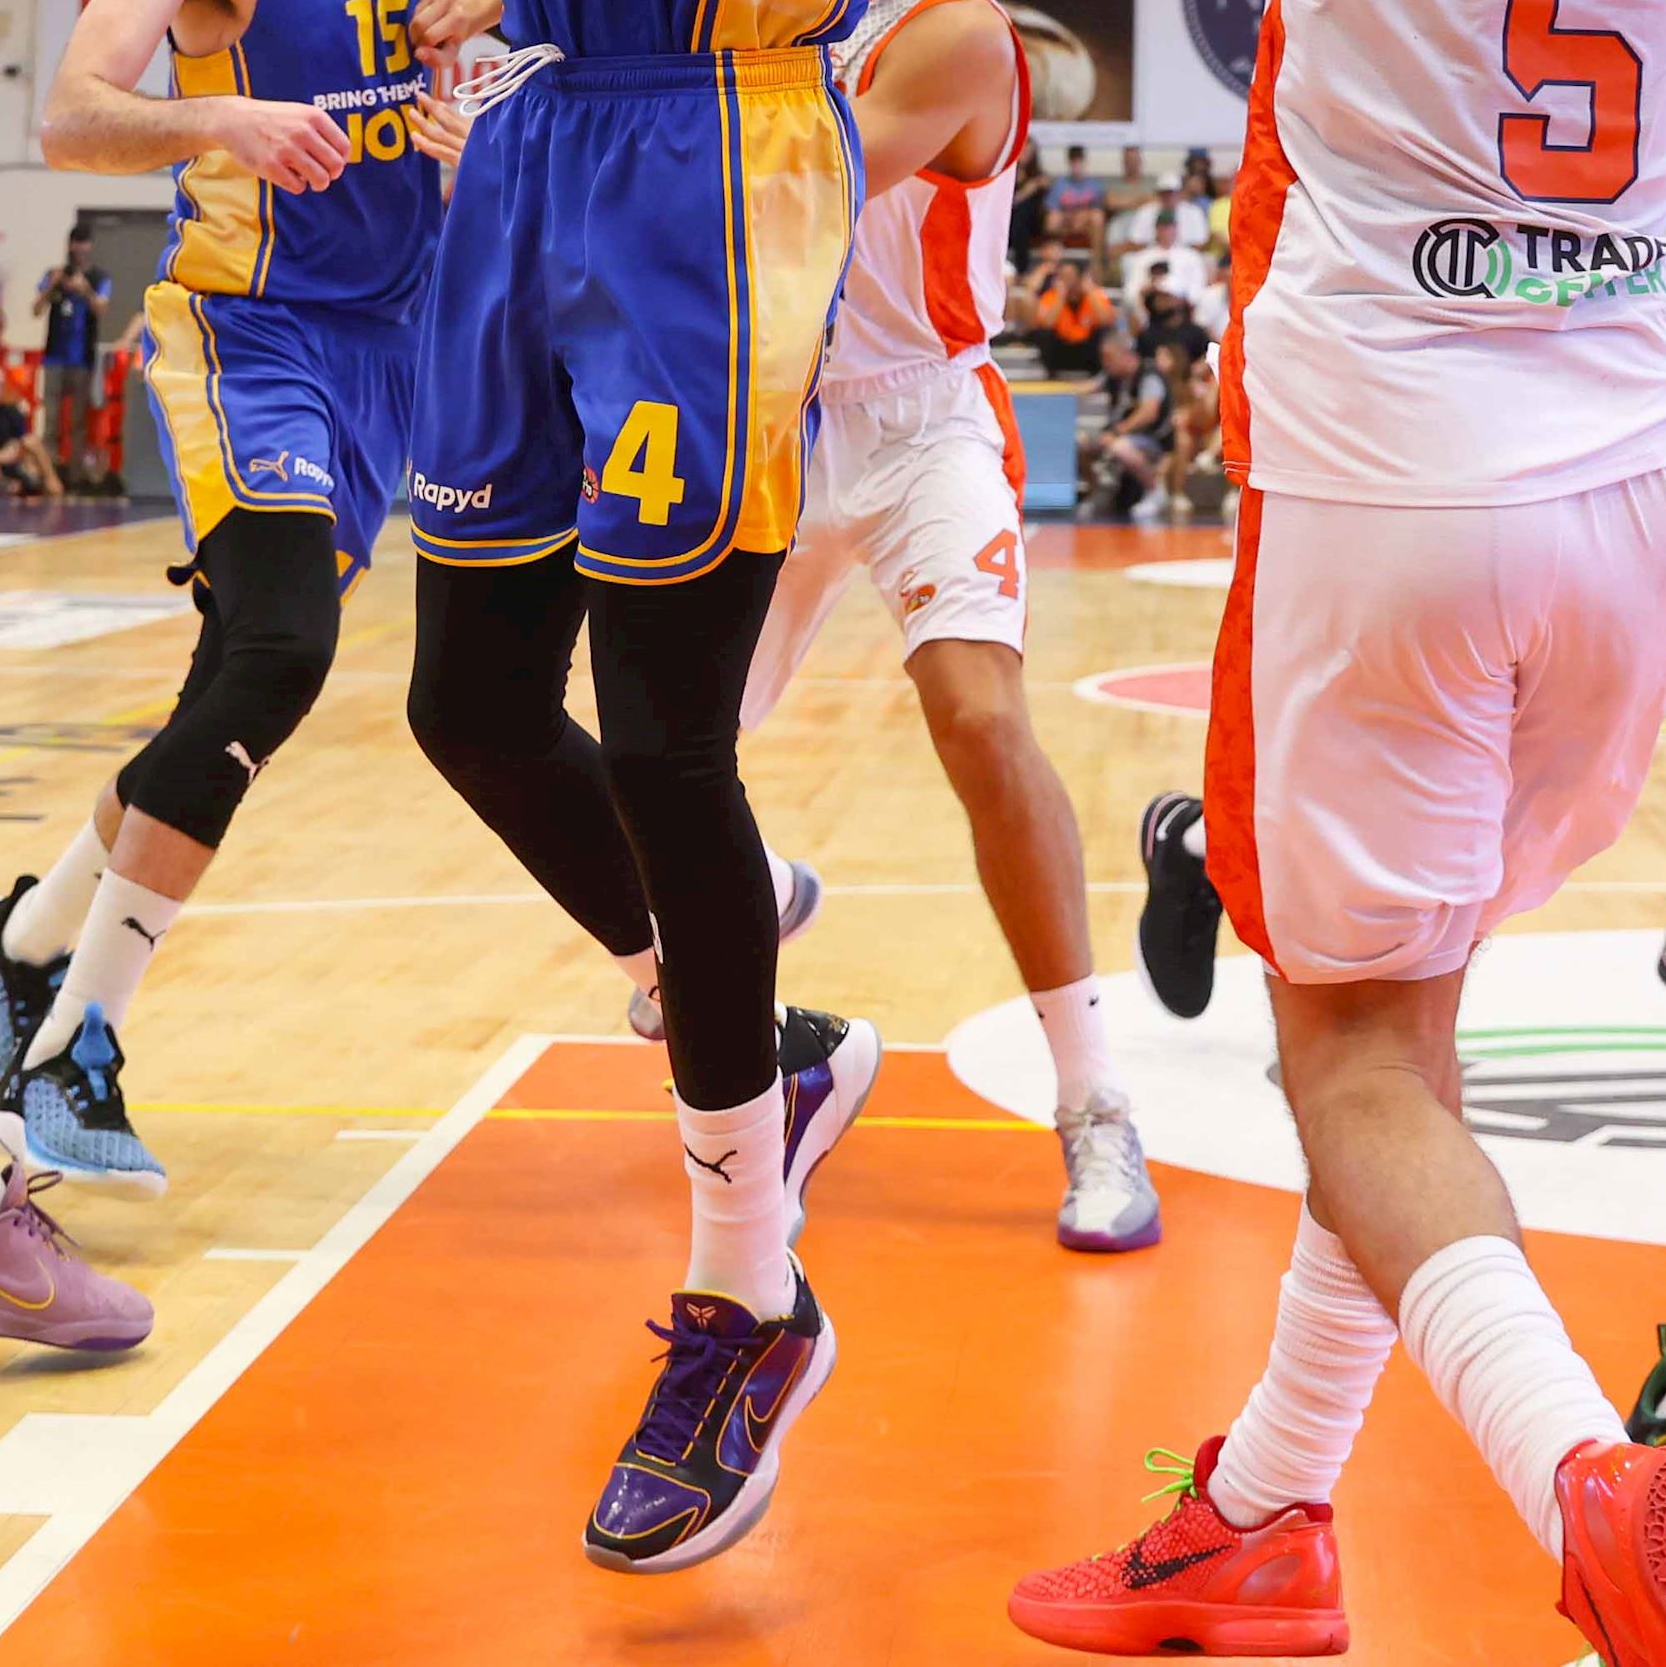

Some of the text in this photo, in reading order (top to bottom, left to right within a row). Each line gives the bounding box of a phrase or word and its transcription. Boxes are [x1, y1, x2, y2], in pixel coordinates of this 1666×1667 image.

[313, 89, 377, 111] BRING
[601, 400, 685, 526] 4
[414, 472, 493, 514] Rapyd
[973, 527, 1020, 601] 4
